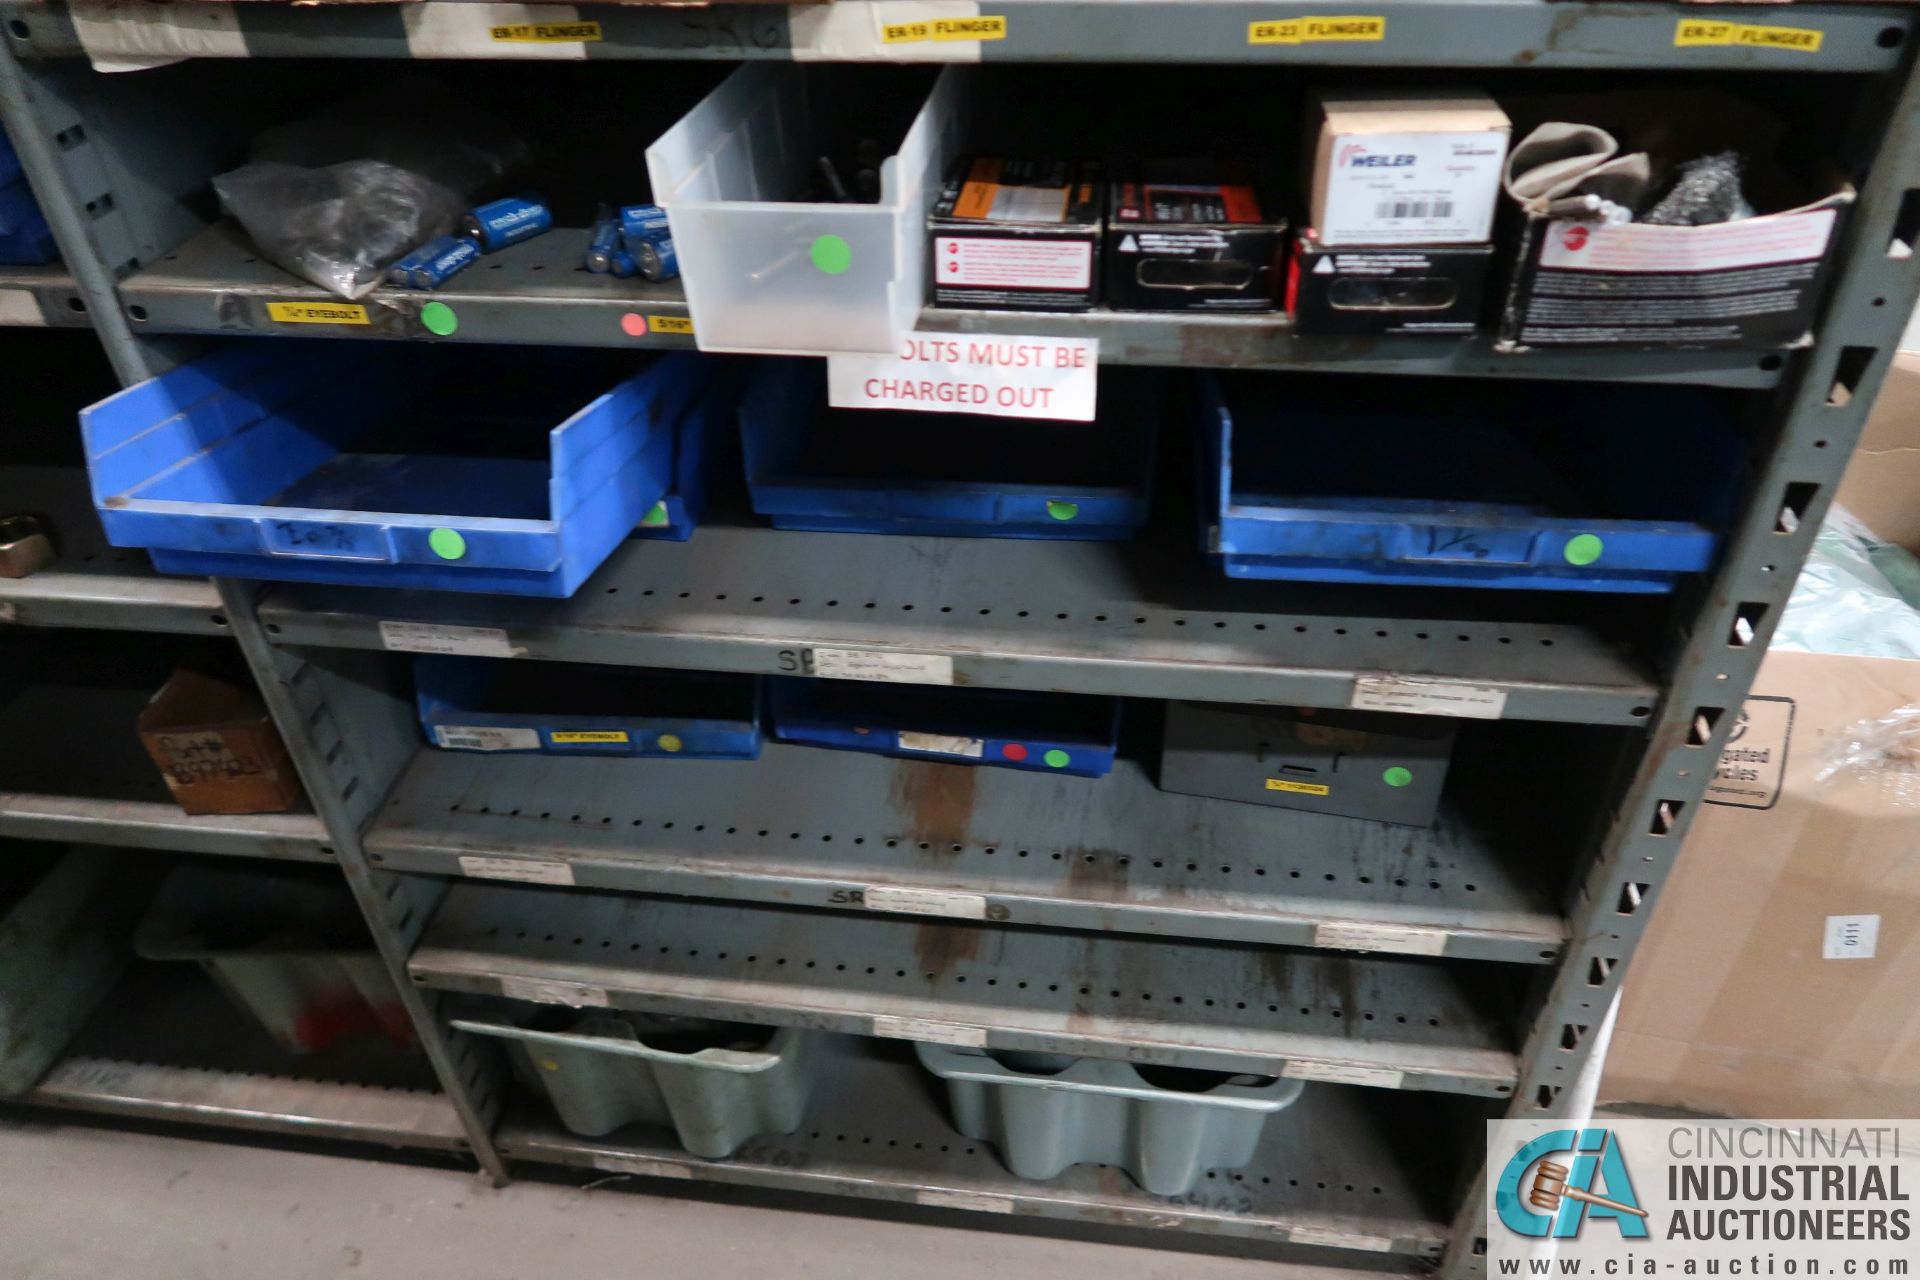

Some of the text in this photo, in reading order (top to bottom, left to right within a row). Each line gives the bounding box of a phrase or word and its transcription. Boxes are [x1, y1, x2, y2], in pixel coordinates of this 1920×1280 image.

[535, 24, 597, 38] FLINGER
[887, 19, 1002, 38] ER-19 FLINGER
[1255, 21, 1379, 38] ER-23 FLINGER
[1682, 25, 1815, 46] ER-27 FLINGER
[1351, 154, 1416, 168] WEILER
[305, 308, 361, 320] EYEBOLT
[968, 342, 1046, 367] MUST
[1055, 346, 1087, 368] BE
[864, 377, 1054, 408] CHARGED OUT
